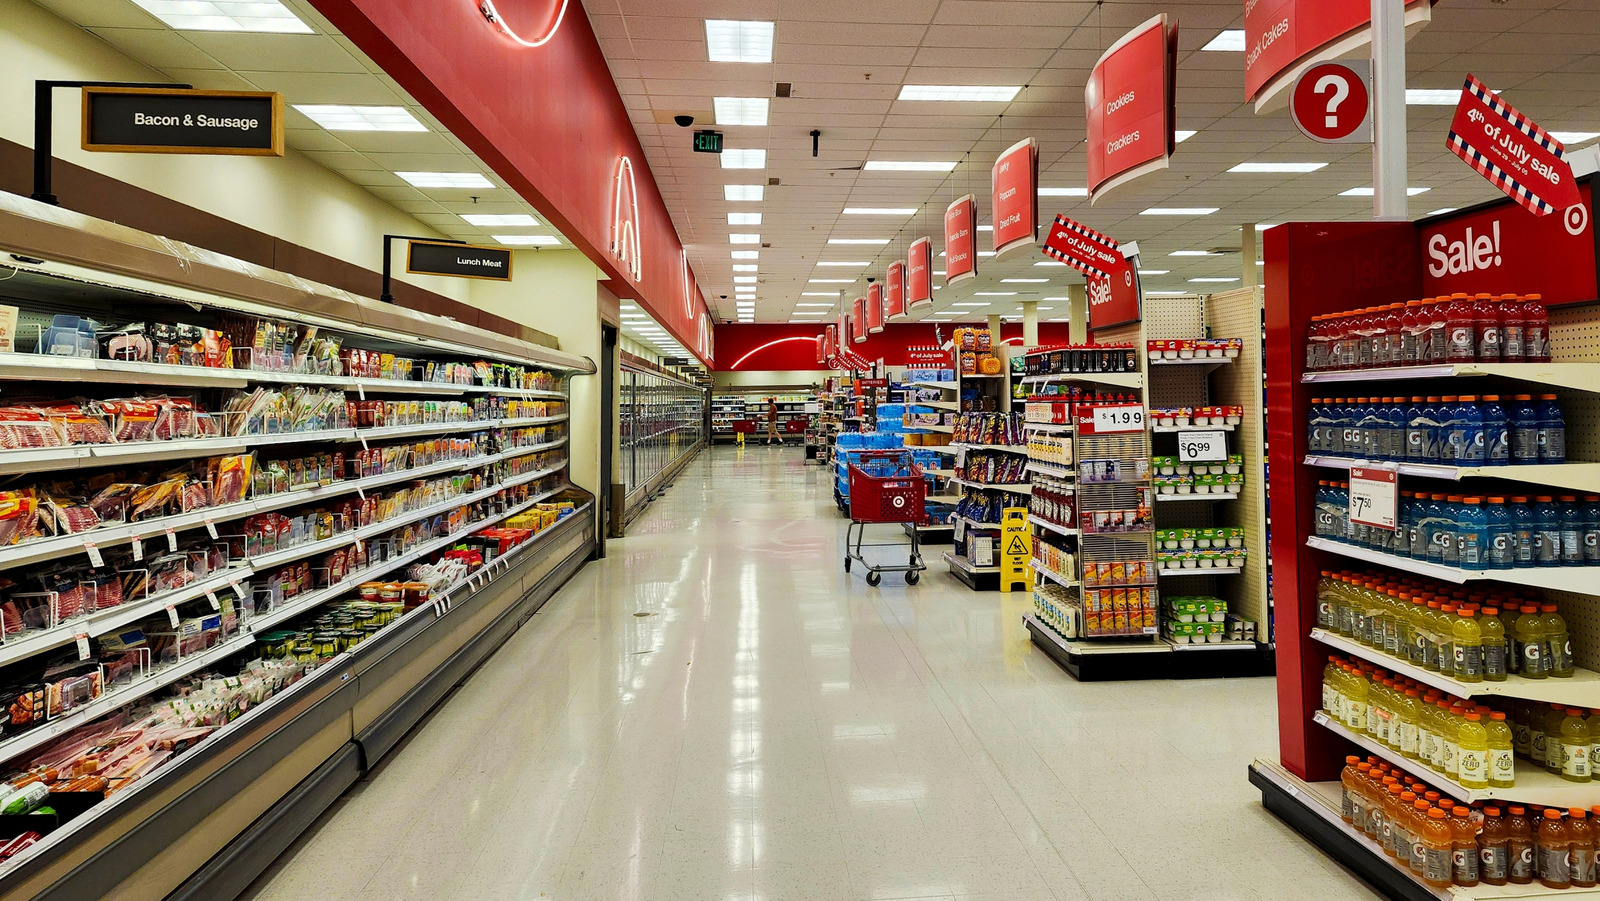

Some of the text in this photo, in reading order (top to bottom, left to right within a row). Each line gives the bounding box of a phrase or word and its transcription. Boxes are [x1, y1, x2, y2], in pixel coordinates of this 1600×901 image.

[1247, 18, 1289, 70] Snack Cakes
[1106, 91, 1135, 115] Cookies
[134, 112, 258, 131] Bacon & Sausage
[699, 135, 719, 150] EXIT
[1106, 130, 1140, 155] Crackers
[1467, 108, 1560, 185] 4th of July sale
[1000, 212, 1021, 230] Dried Fruit
[1056, 231, 1116, 264] 4th of July sale
[1428, 220, 1502, 278] Sale!
[456, 256, 502, 268] Lunch Meat
[1090, 277, 1112, 306] Sale!
[1452, 329, 1467, 344] G
[1483, 330, 1497, 344] G
[1344, 430, 1352, 442] G
[1352, 430, 1360, 442] G
[1409, 432, 1420, 444] G
[1494, 537, 1505, 549] G
[1585, 534, 1596, 546] G
[1525, 645, 1539, 659] G
[1462, 760, 1480, 768] ZERO
[1453, 851, 1465, 866] G
[1481, 849, 1494, 864] G
